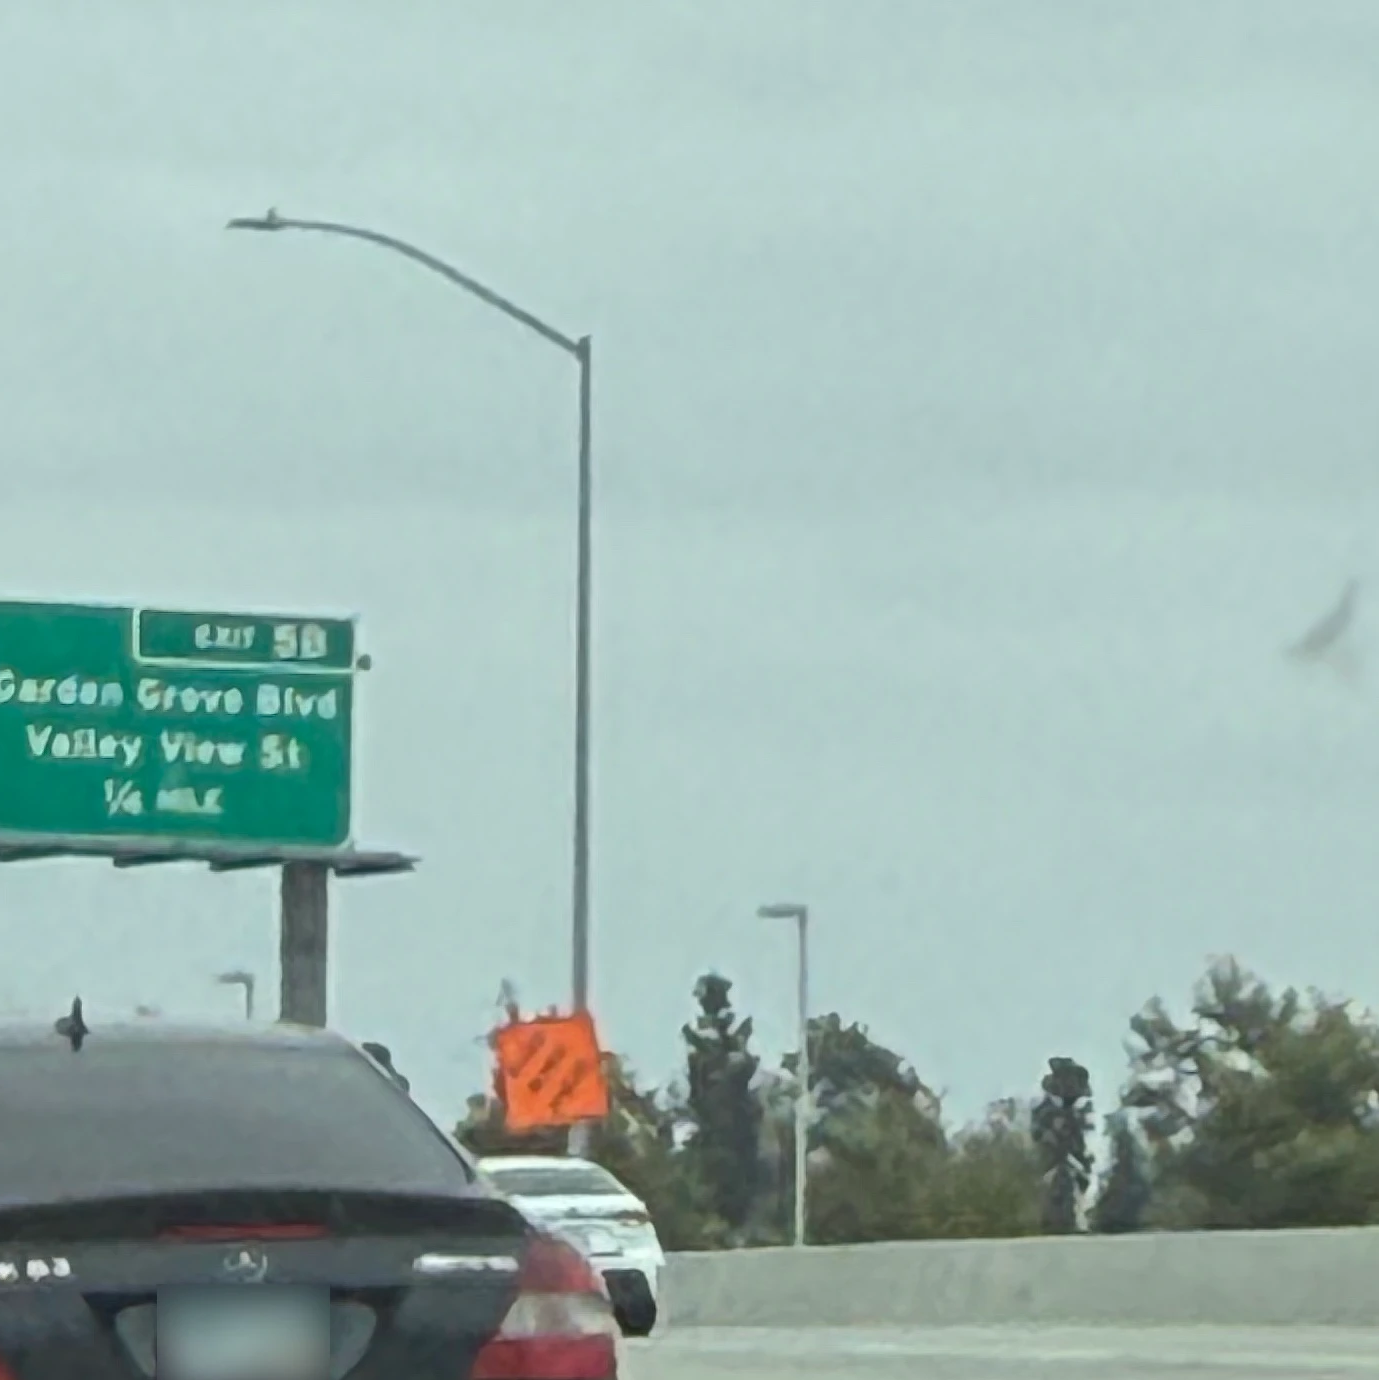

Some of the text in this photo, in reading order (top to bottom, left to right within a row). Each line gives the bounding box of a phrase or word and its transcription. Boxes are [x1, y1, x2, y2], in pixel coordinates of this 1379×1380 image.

[136, 677, 243, 713] Grove
[255, 683, 338, 719] Blvd
[26, 723, 302, 769] Valley View St
